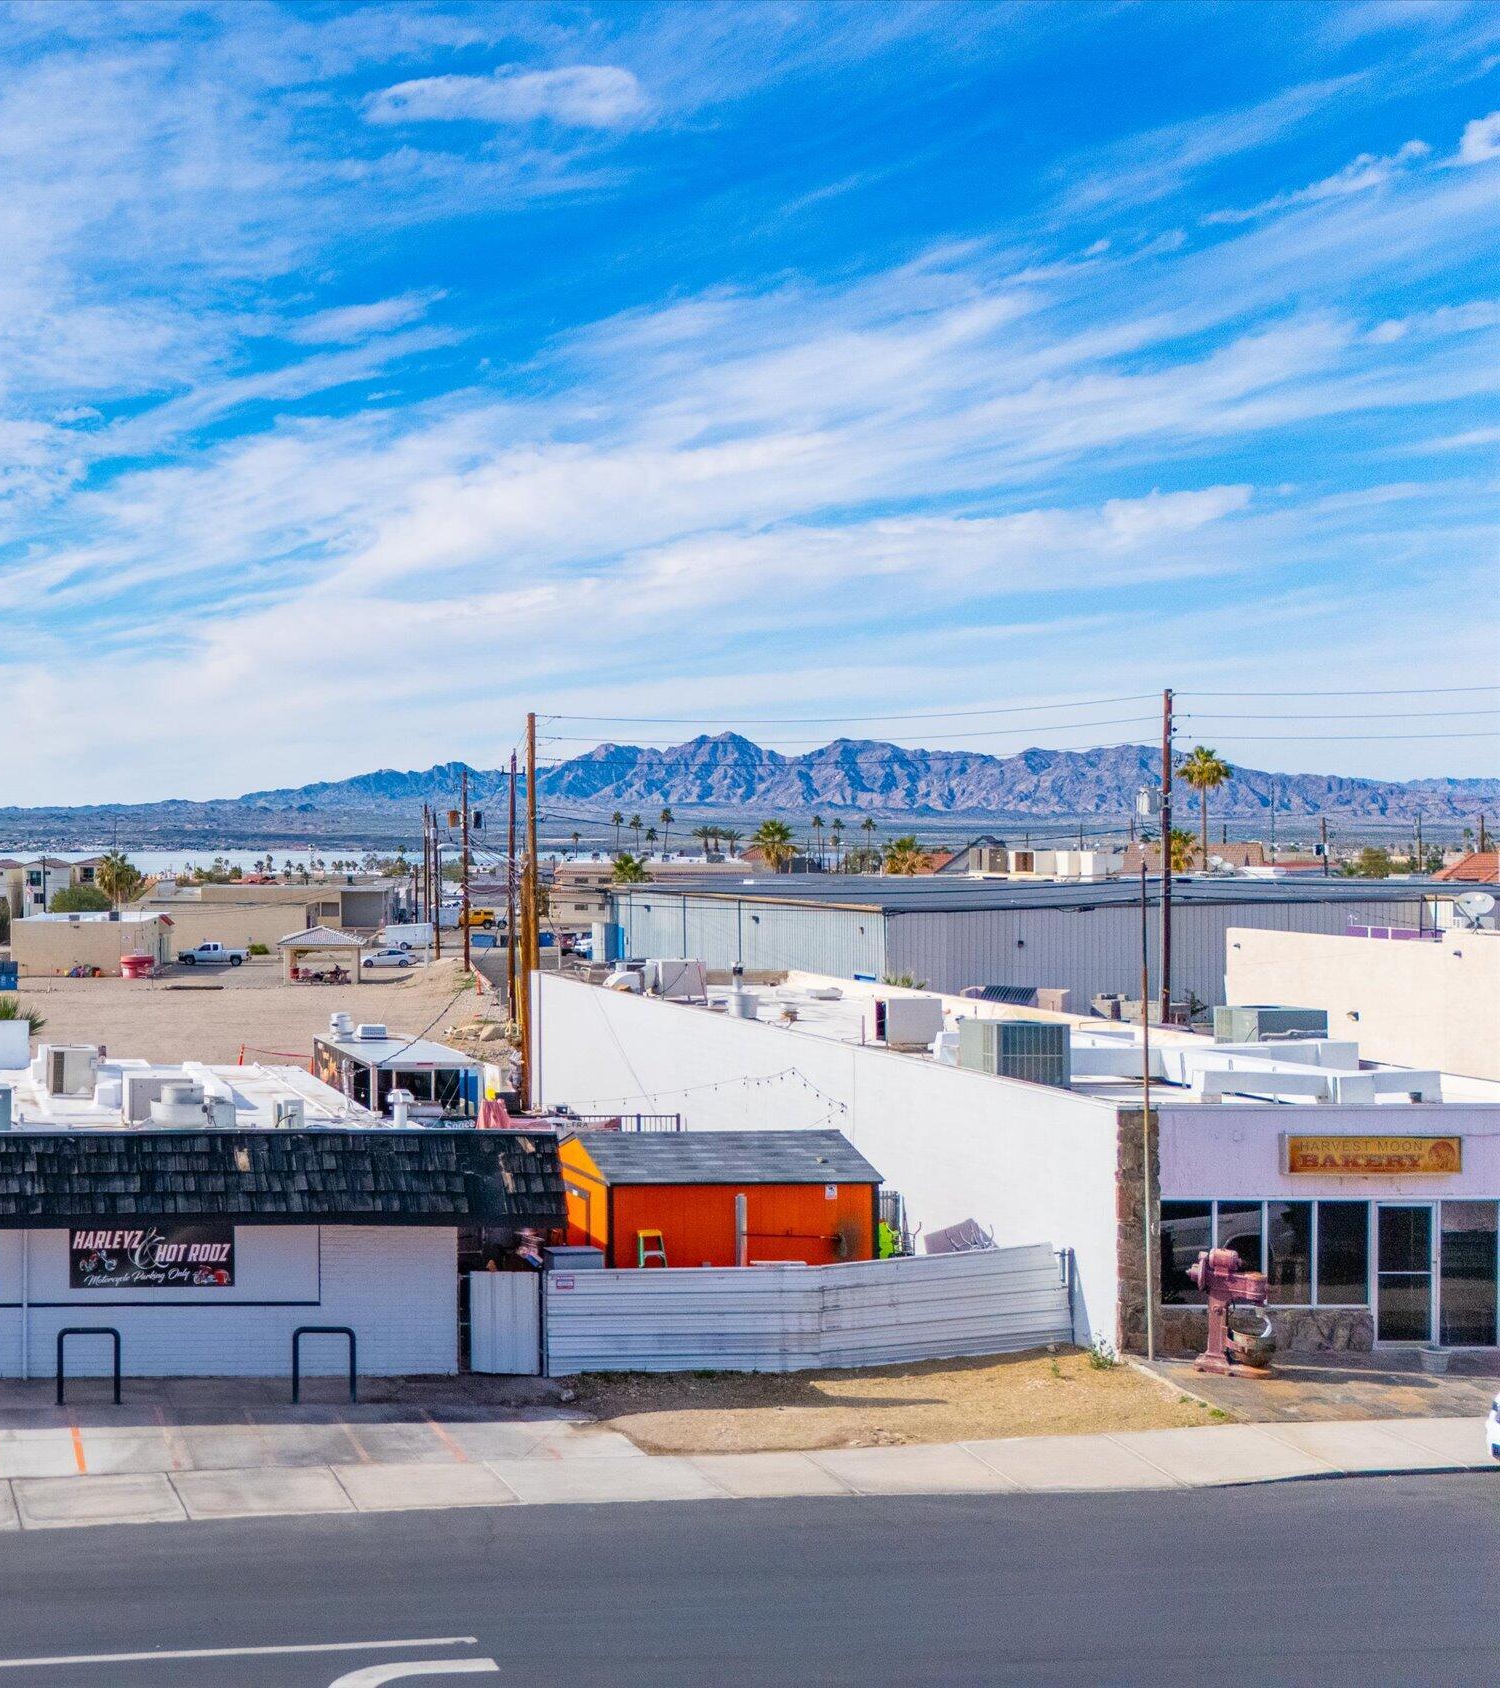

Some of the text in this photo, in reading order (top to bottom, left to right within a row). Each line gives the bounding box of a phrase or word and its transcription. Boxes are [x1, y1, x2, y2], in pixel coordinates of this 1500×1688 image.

[1300, 1141, 1423, 1152] HARVEST MOON
[1300, 1153, 1422, 1168] BAKERY
[72, 1230, 143, 1250] HARLEYZ
[155, 1243, 231, 1262] HOT RODZ
[84, 1267, 190, 1286] Motorcycle Parking Only
